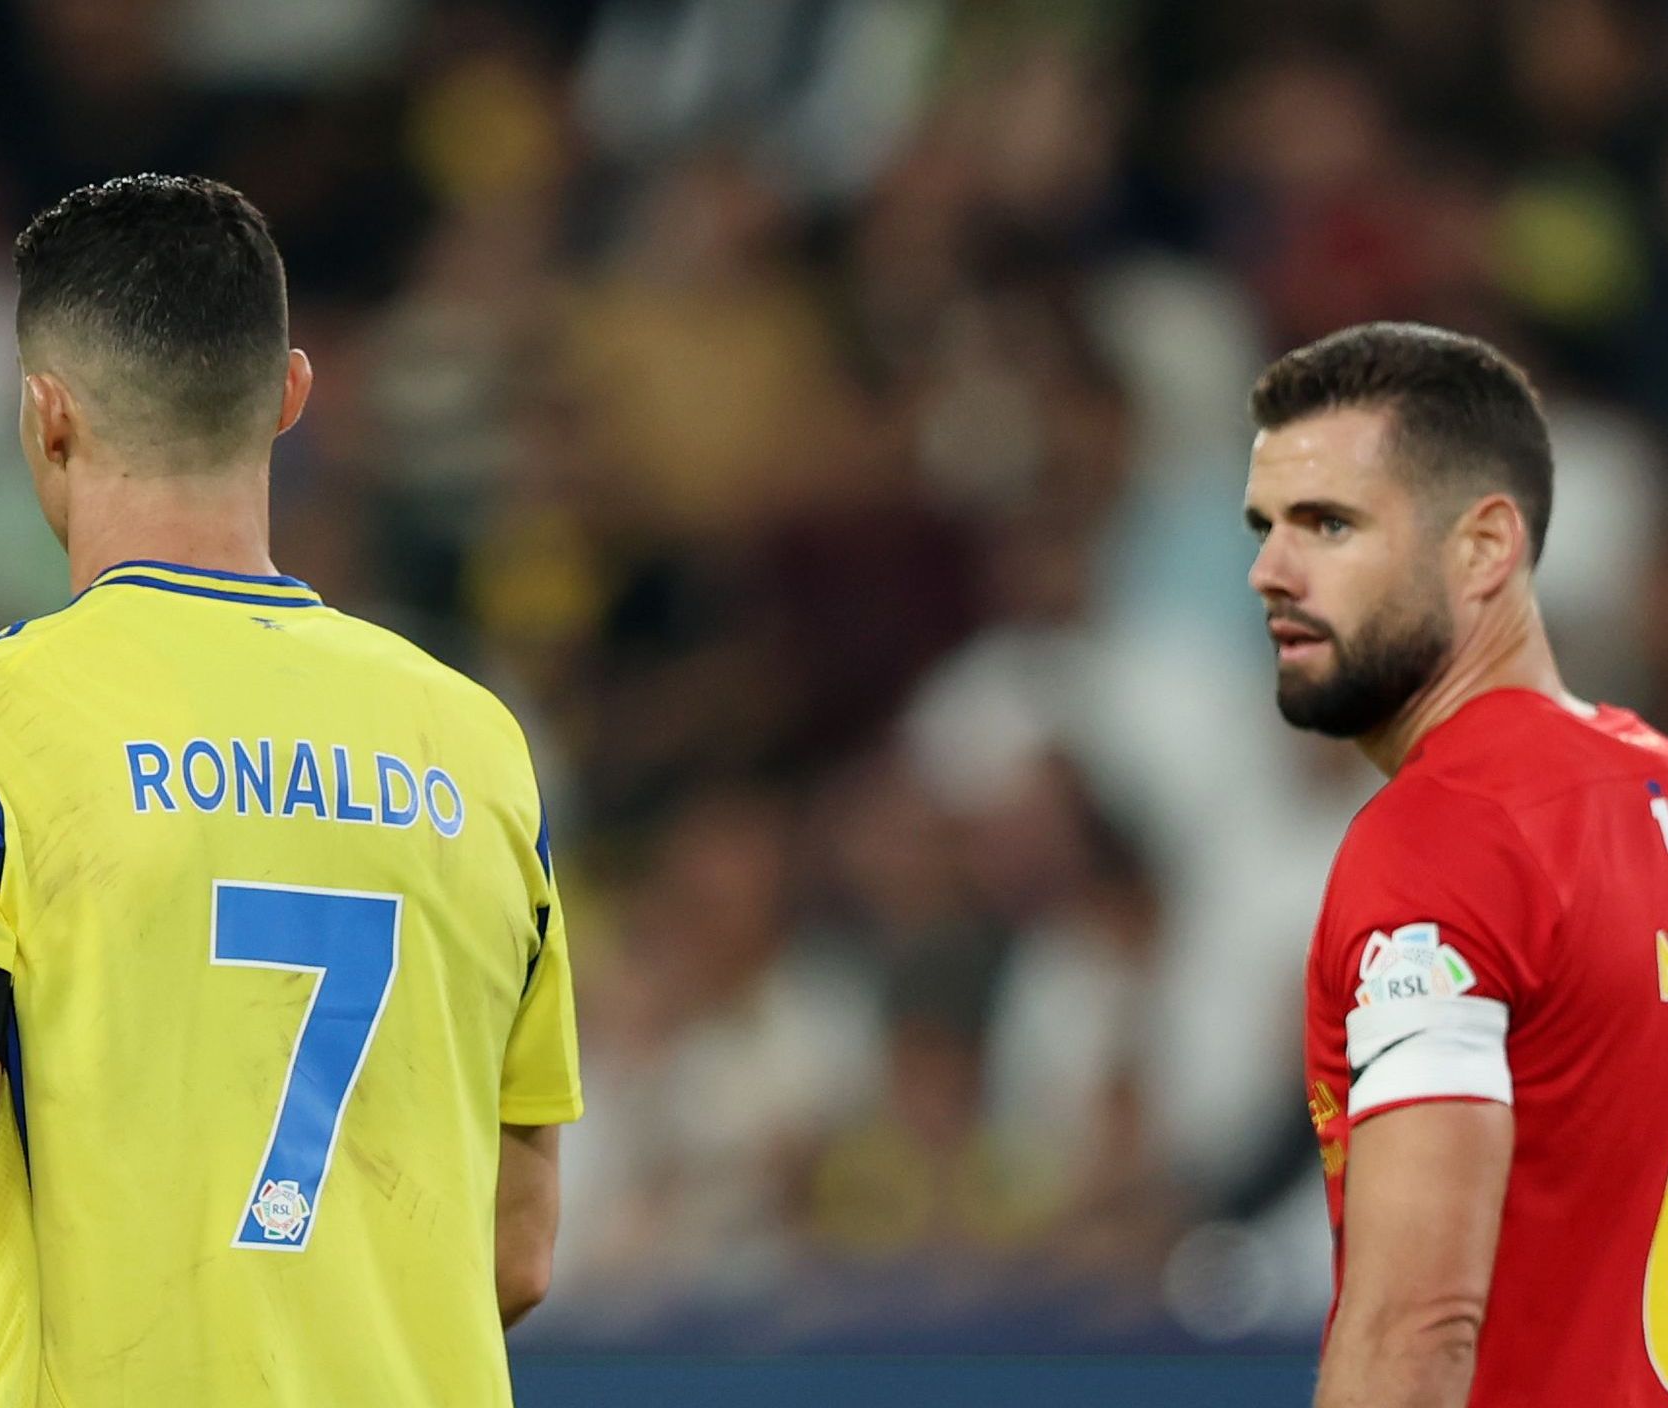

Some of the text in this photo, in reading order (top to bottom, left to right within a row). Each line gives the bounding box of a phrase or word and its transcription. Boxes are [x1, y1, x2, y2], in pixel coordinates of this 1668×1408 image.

[125, 737, 464, 838] RONALDO
[1388, 975, 1428, 999] RSL
[210, 880, 403, 1252] 7
[272, 1204, 291, 1215] RSL
